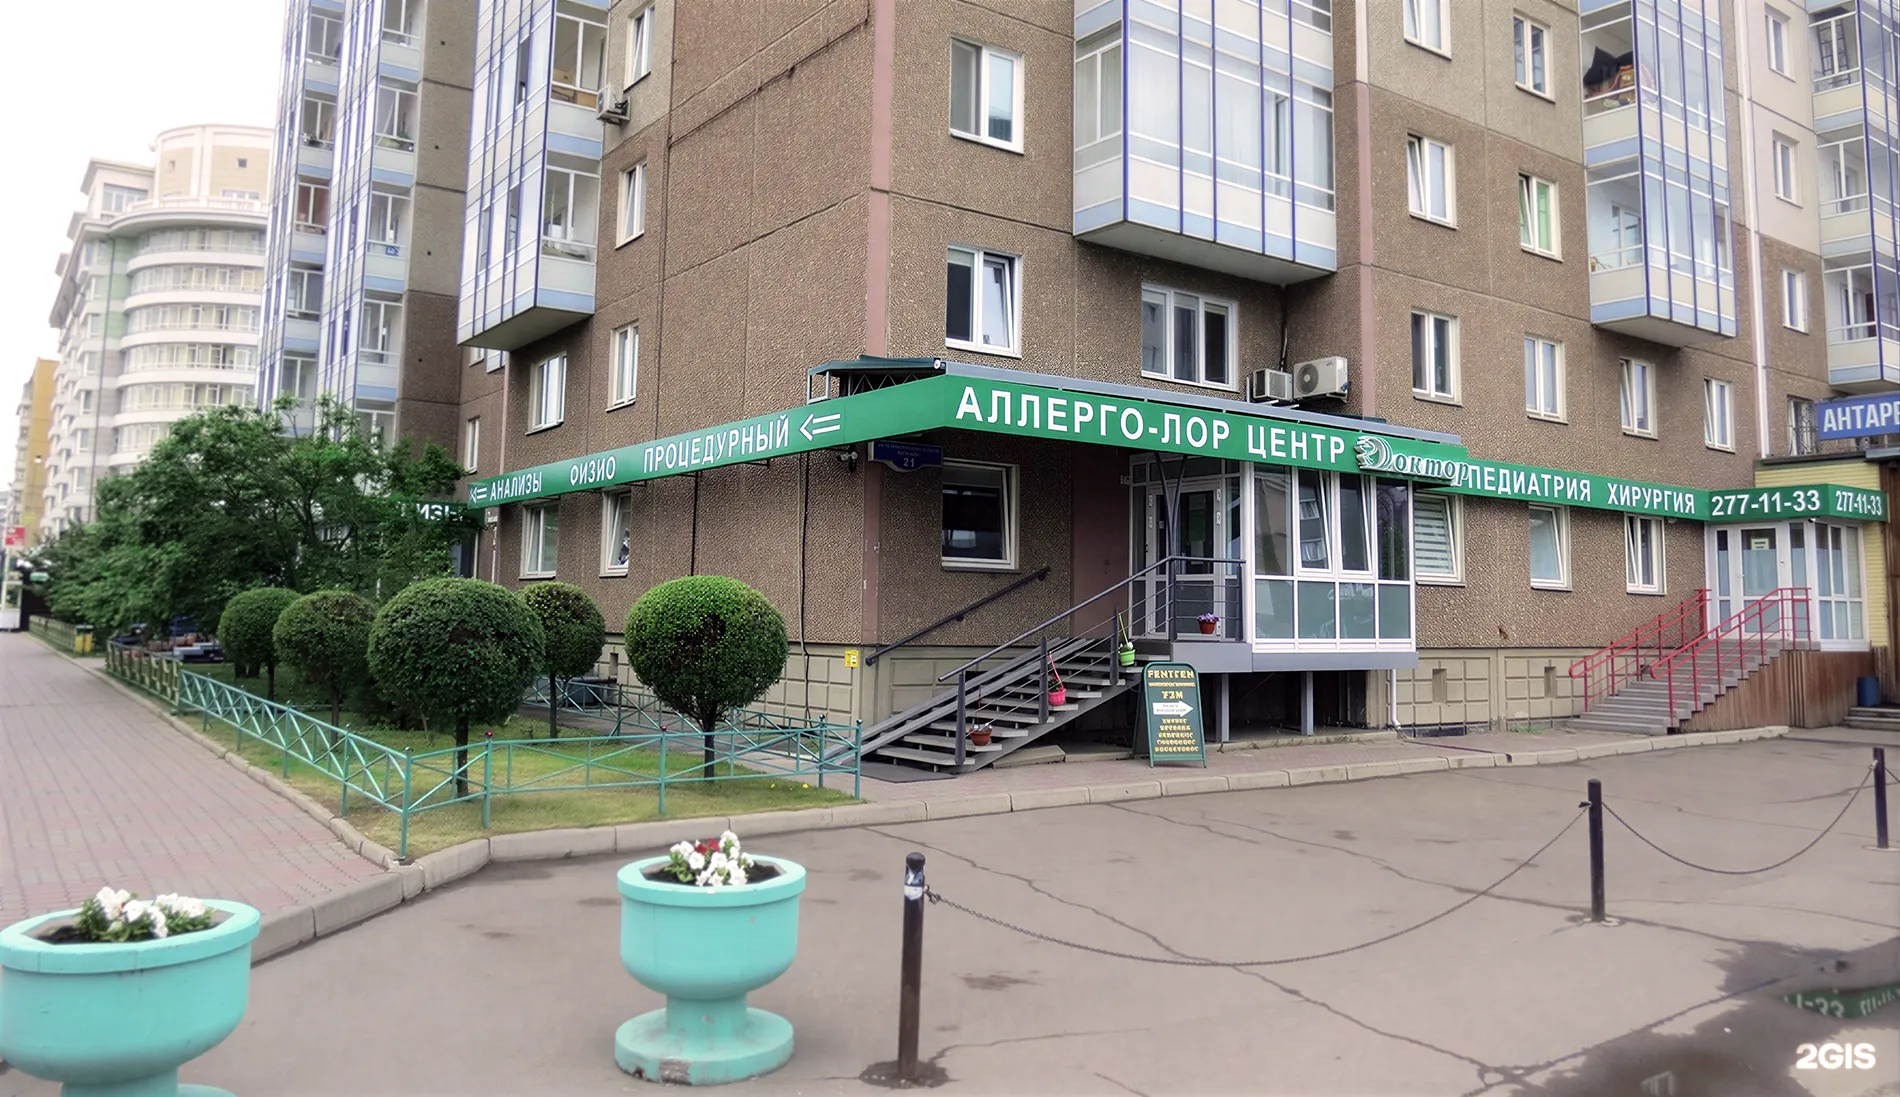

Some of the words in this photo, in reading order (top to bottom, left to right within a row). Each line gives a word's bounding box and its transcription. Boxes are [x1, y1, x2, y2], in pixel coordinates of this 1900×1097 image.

[955, 386, 1231, 450] АЛЛЕРГО-ЛОР
[1246, 424, 1345, 464] ЦЕНТР
[489, 471, 543, 501] АНАЛИЗЫ
[569, 456, 616, 486] ФИЗИО
[643, 414, 790, 474] ПРОЦЕДУРНЫЙ
[903, 457, 915, 468] 21
[1354, 435, 1470, 487] Доктор
[1468, 465, 1592, 502] ПЕДИАТРИЯ
[1607, 482, 1696, 515] ХИРУРГИЯ
[1711, 489, 1821, 516] 277-11-33
[1835, 490, 1882, 516] 277-11-33
